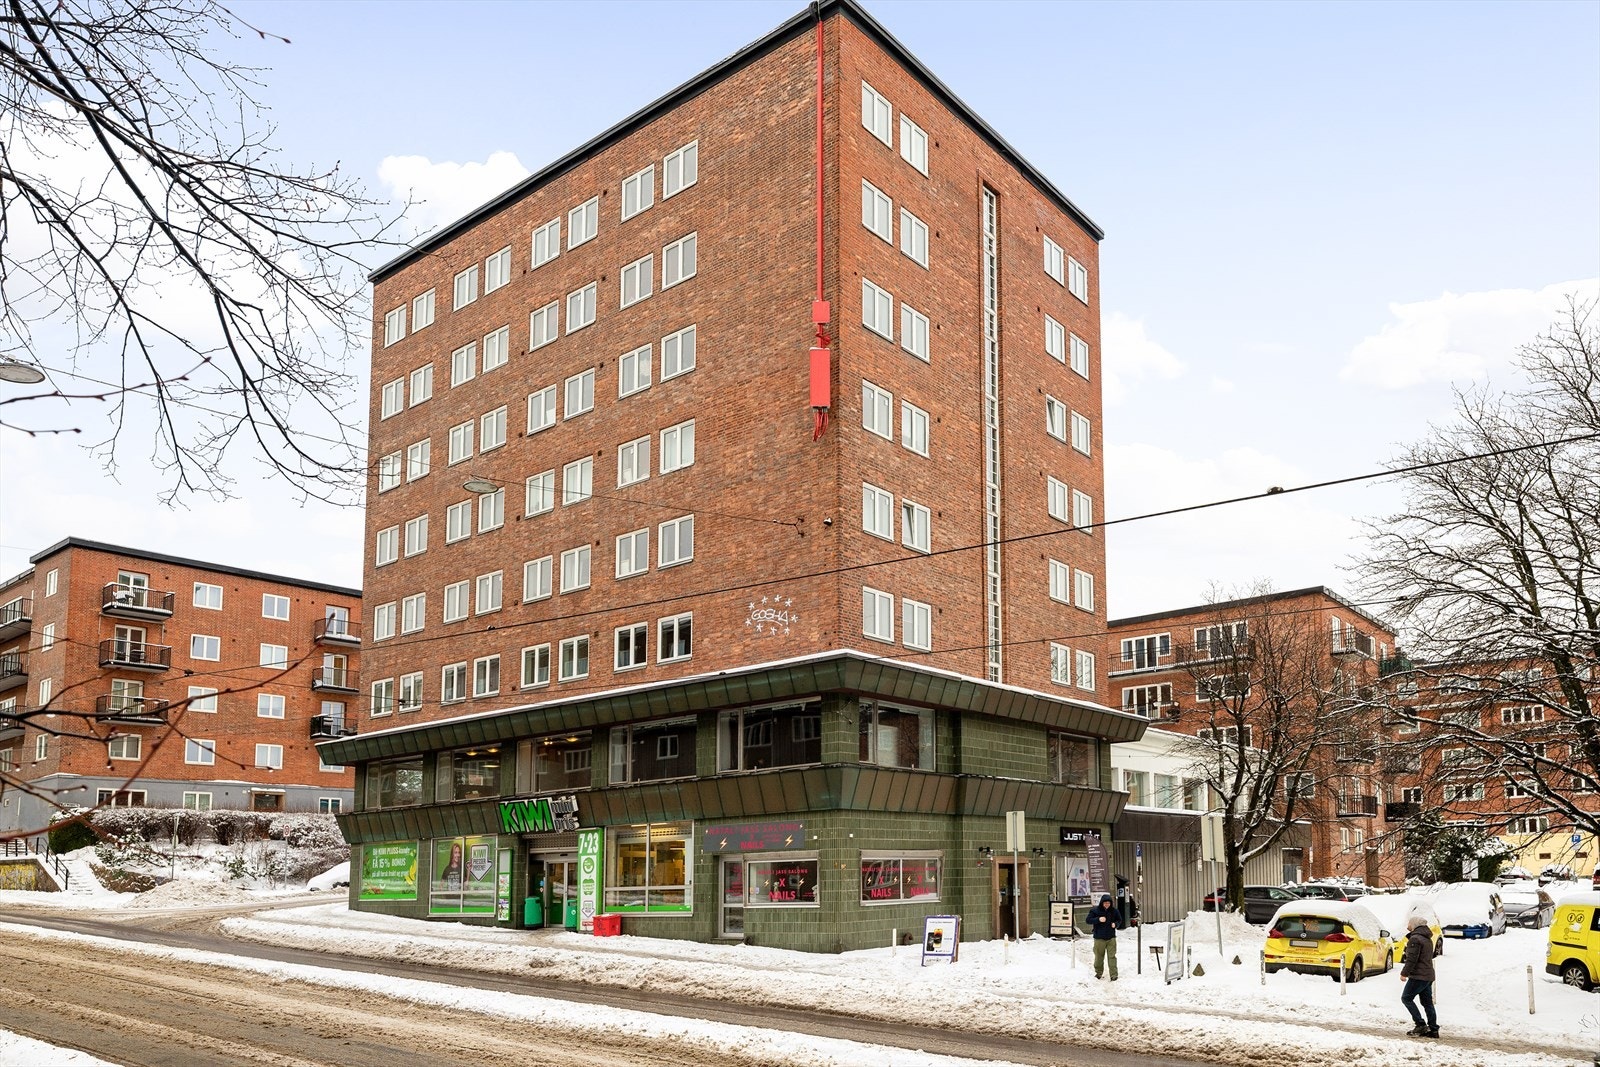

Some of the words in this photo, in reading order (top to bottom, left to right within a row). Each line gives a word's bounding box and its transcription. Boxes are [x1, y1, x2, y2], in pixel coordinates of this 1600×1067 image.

[751, 609, 789, 625] GOSHA
[499, 799, 554, 833] KIWI
[554, 815, 579, 833] pris
[579, 833, 599, 854] 7-23
[740, 841, 765, 850] NAILS
[391, 857, 407, 866] BONUS
[779, 878, 786, 887] X
[768, 891, 796, 900] NAILS
[871, 888, 892, 898] NAILS
[910, 888, 929, 896] NAILS
